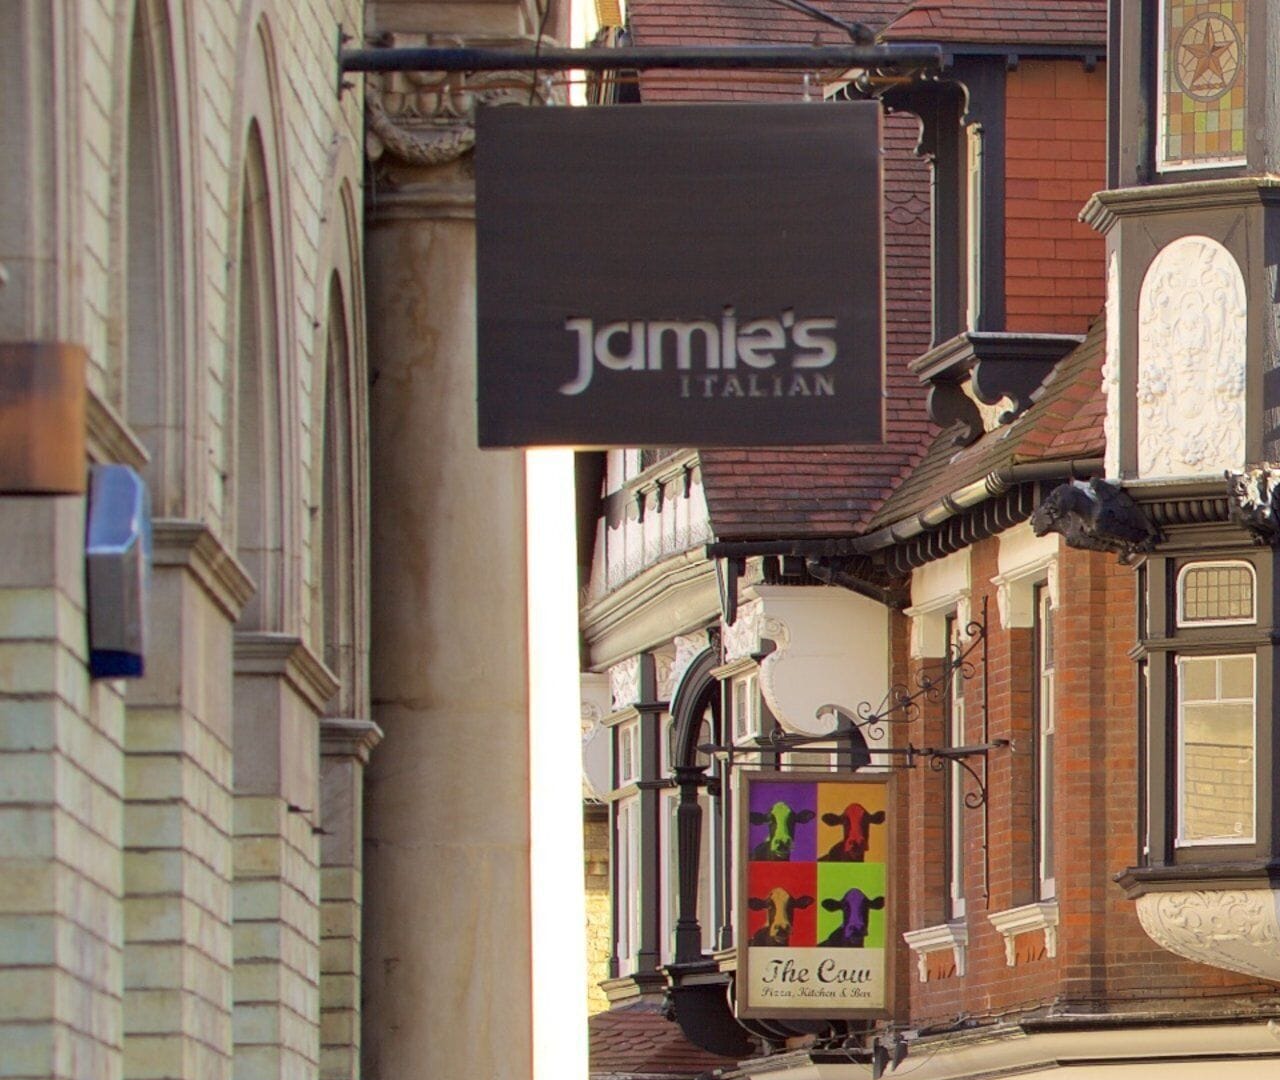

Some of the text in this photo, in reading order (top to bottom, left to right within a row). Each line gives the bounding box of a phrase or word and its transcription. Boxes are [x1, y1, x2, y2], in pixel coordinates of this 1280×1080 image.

[680, 374, 836, 398] ITALIAN
[762, 958, 872, 983] The Cow
